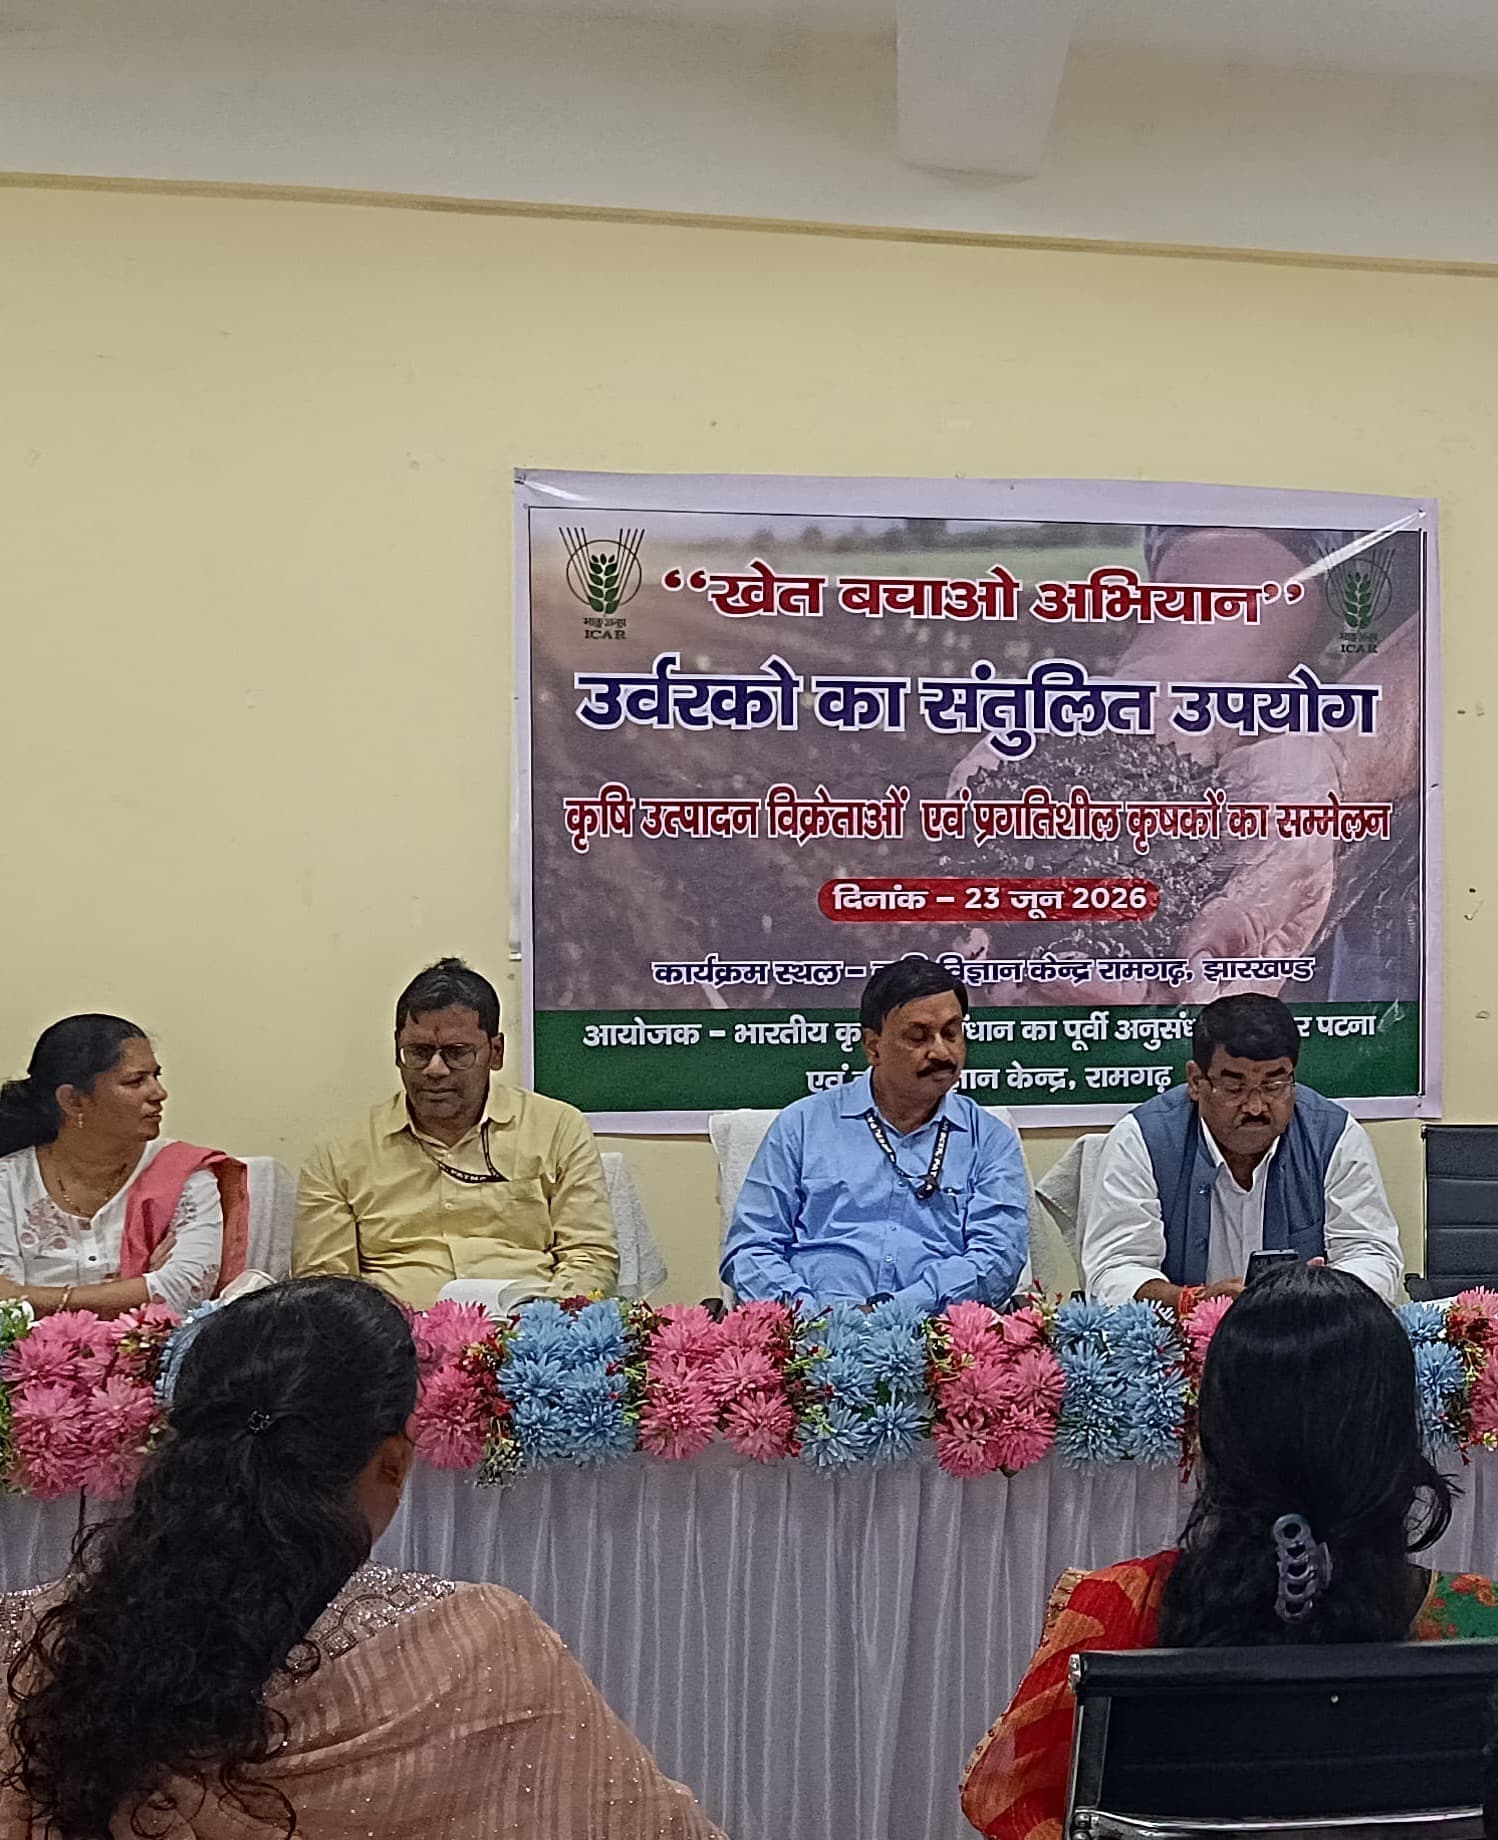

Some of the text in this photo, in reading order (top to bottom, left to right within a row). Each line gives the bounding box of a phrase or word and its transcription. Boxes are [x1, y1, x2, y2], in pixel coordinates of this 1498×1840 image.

[839, 566, 1021, 621] बचाओ
[584, 629, 627, 640] ICAR
[1340, 644, 1378, 654] ICAR
[574, 652, 1384, 762] उर्वरको का संतुलित उपयोग
[563, 782, 1393, 857] कृषि उत्पादन विक्रेताओं एवं प्रगतिशील कृषकों का सम्मेलन
[832, 883, 927, 911] दिनांक
[965, 887, 1000, 910] 23
[1010, 889, 1065, 918] जून
[1072, 887, 1148, 910] 2026
[651, 953, 771, 989] कार्यक्रम
[1027, 953, 1093, 988] केन्द्र
[1202, 956, 1316, 982] झारखण्ड
[583, 1016, 702, 1047] आयोजक
[734, 1013, 828, 1045] भारतीय
[1021, 1018, 1058, 1042] का
[1063, 1008, 1109, 1050] पूर्वी
[1315, 1015, 1377, 1037] पटना
[1084, 1065, 1173, 1094] रामगढ़
